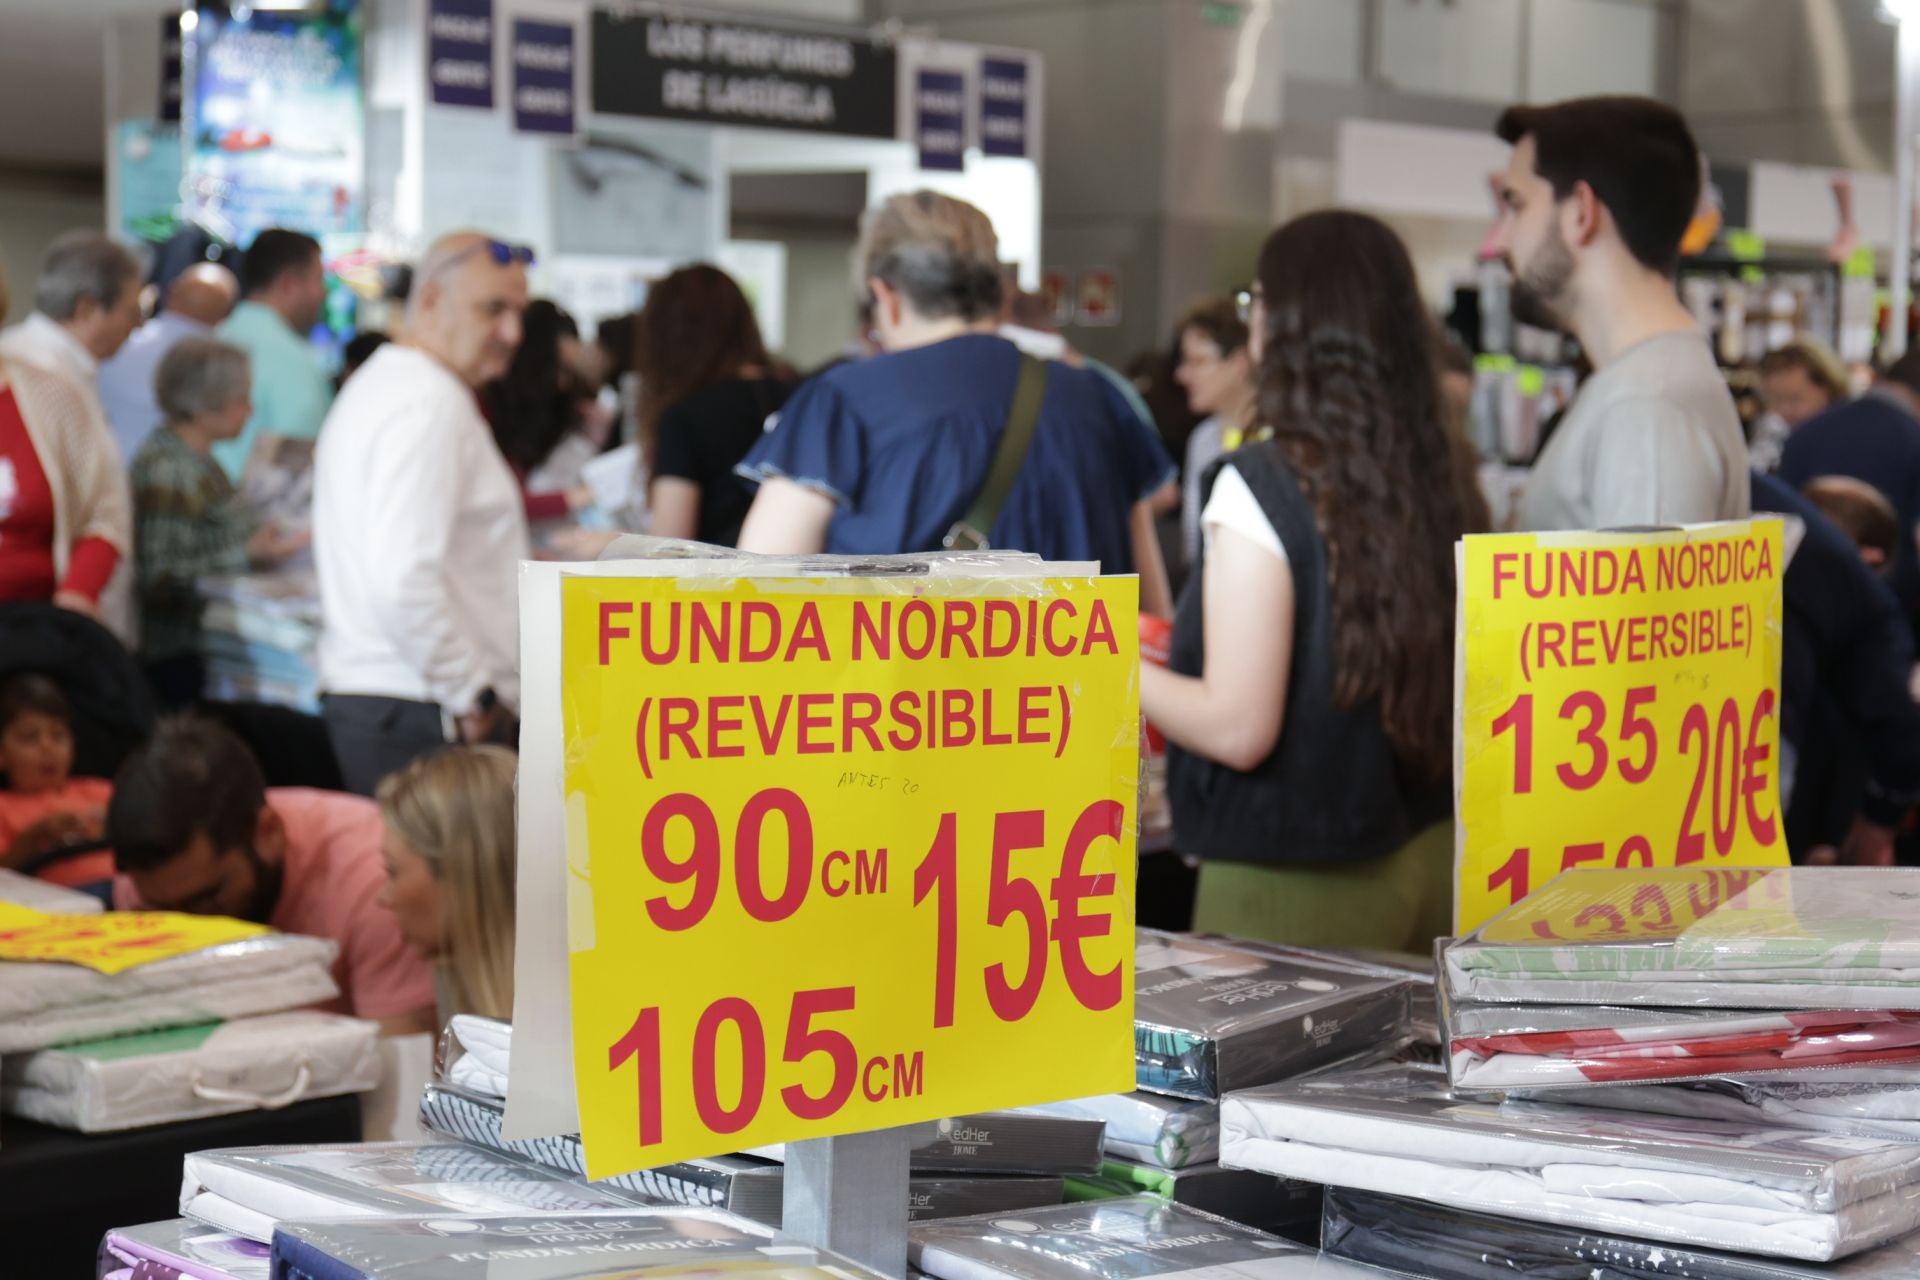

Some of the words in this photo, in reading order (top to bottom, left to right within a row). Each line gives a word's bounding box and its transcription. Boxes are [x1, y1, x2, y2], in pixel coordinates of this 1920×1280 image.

[1493, 549, 1646, 599] FUNDA
[599, 600, 831, 665] FUNDA
[1520, 603, 1754, 682] (REVERSIBLE)
[636, 686, 1072, 779] (REVERSIBLE)
[1492, 685, 1658, 794] 135
[1675, 687, 1777, 869] 20€
[913, 799, 1125, 1028] 15€
